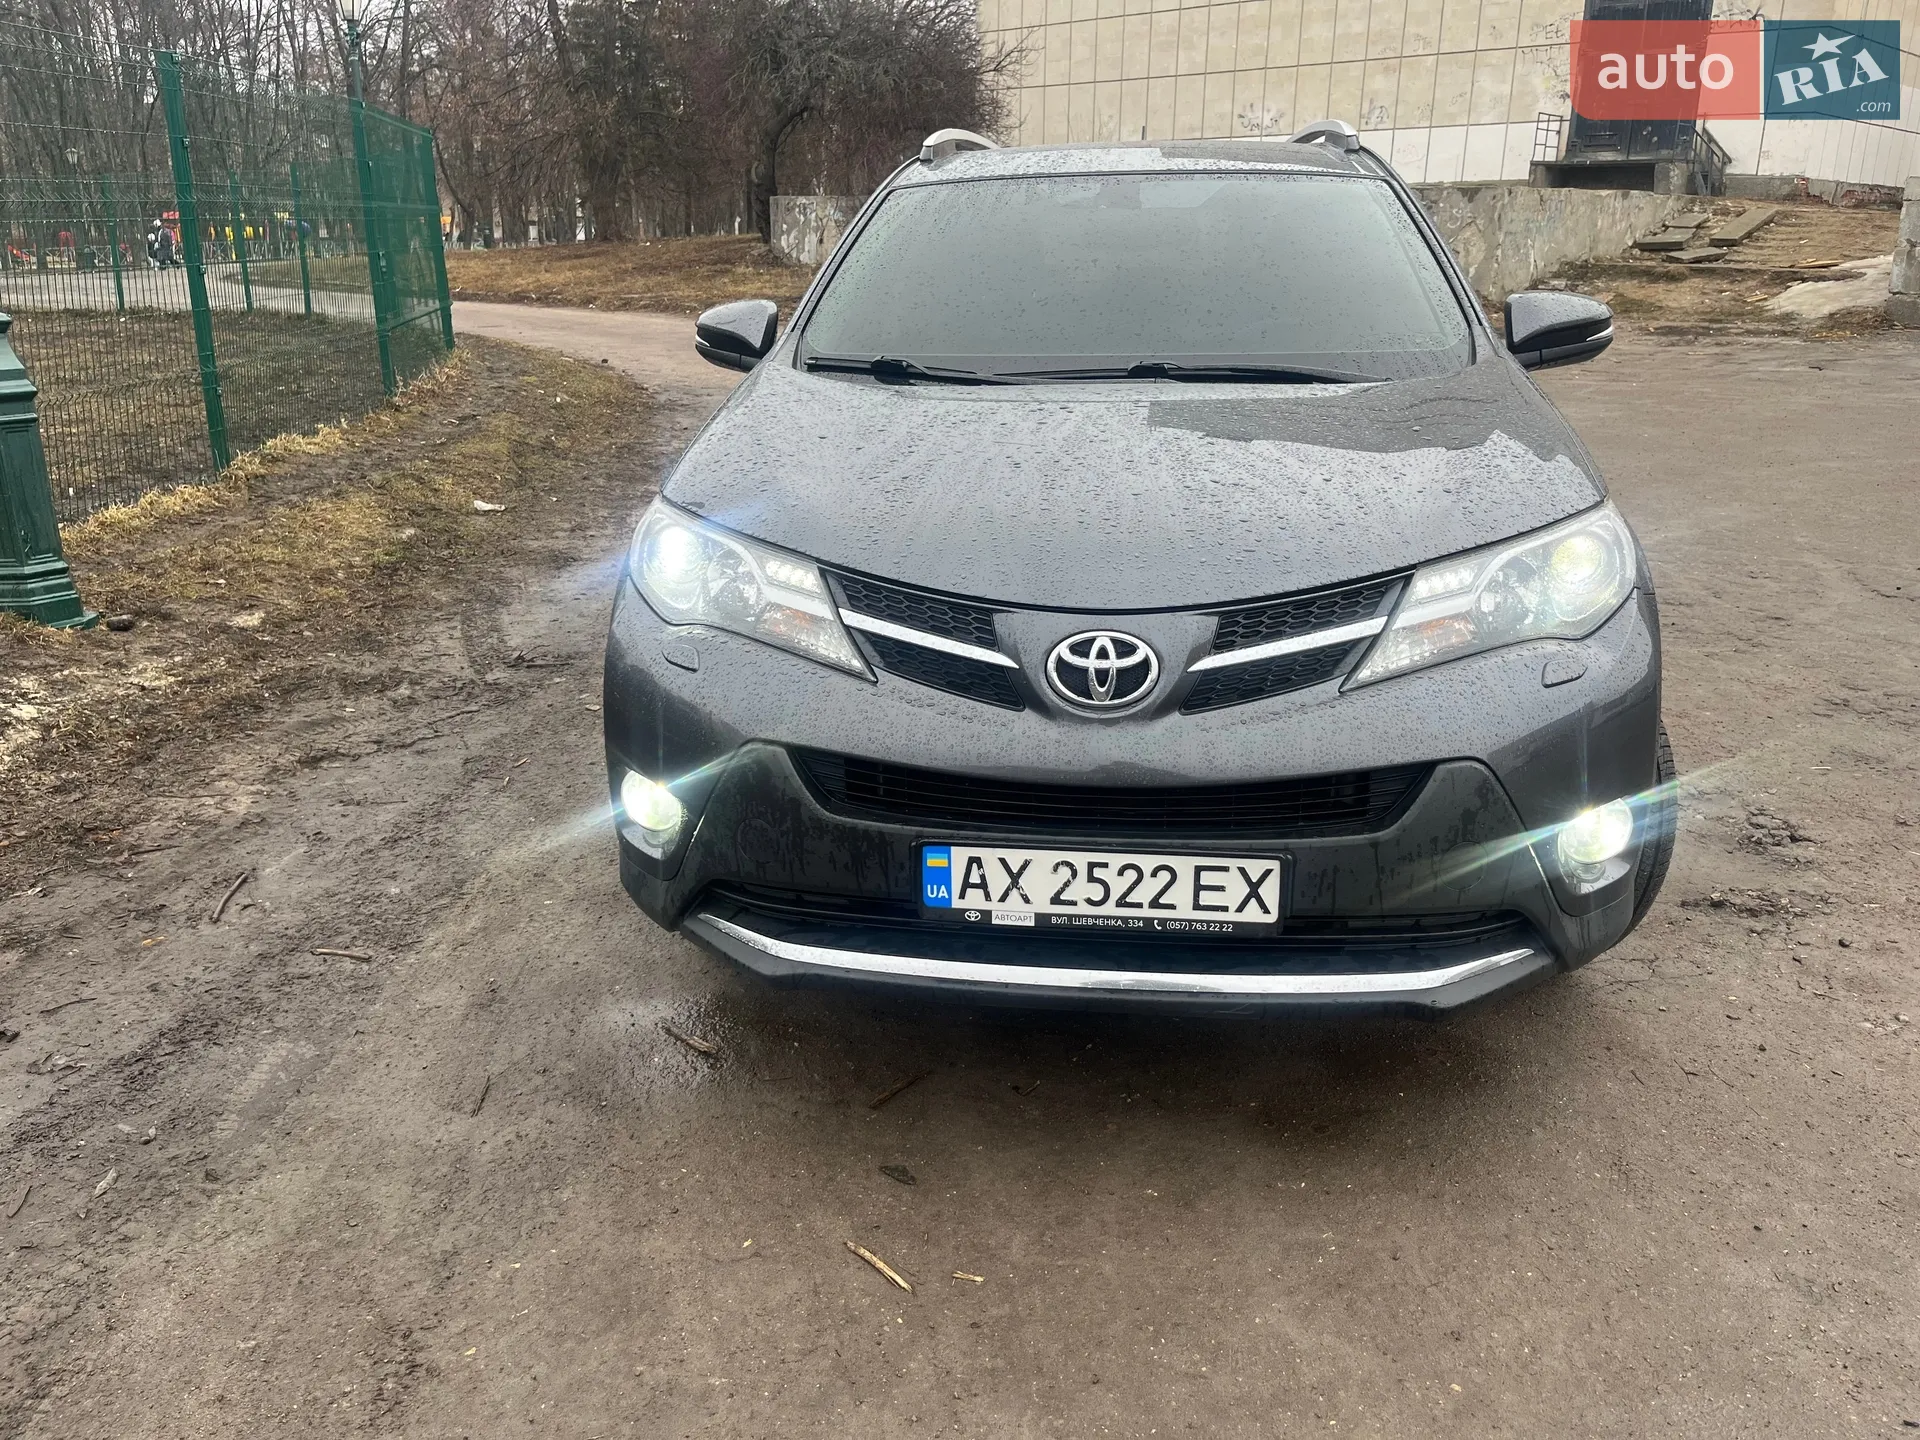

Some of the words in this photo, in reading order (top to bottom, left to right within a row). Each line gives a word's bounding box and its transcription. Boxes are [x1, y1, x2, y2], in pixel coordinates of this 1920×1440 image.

[958, 855, 1033, 905] AX
[1049, 860, 1178, 910] 2522
[1192, 864, 1275, 915] EX
[927, 884, 949, 899] UA
[994, 913, 1033, 923] АВТОАРТ
[1051, 916, 1070, 925] ВУЛ.
[1072, 917, 1126, 928] ШЕВЧЕНКА,
[1127, 919, 1144, 928] 334
[1166, 920, 1189, 931] (057)
[1191, 922, 1207, 931] 763
[1209, 922, 1220, 931] 22
[1222, 923, 1233, 932] 22
